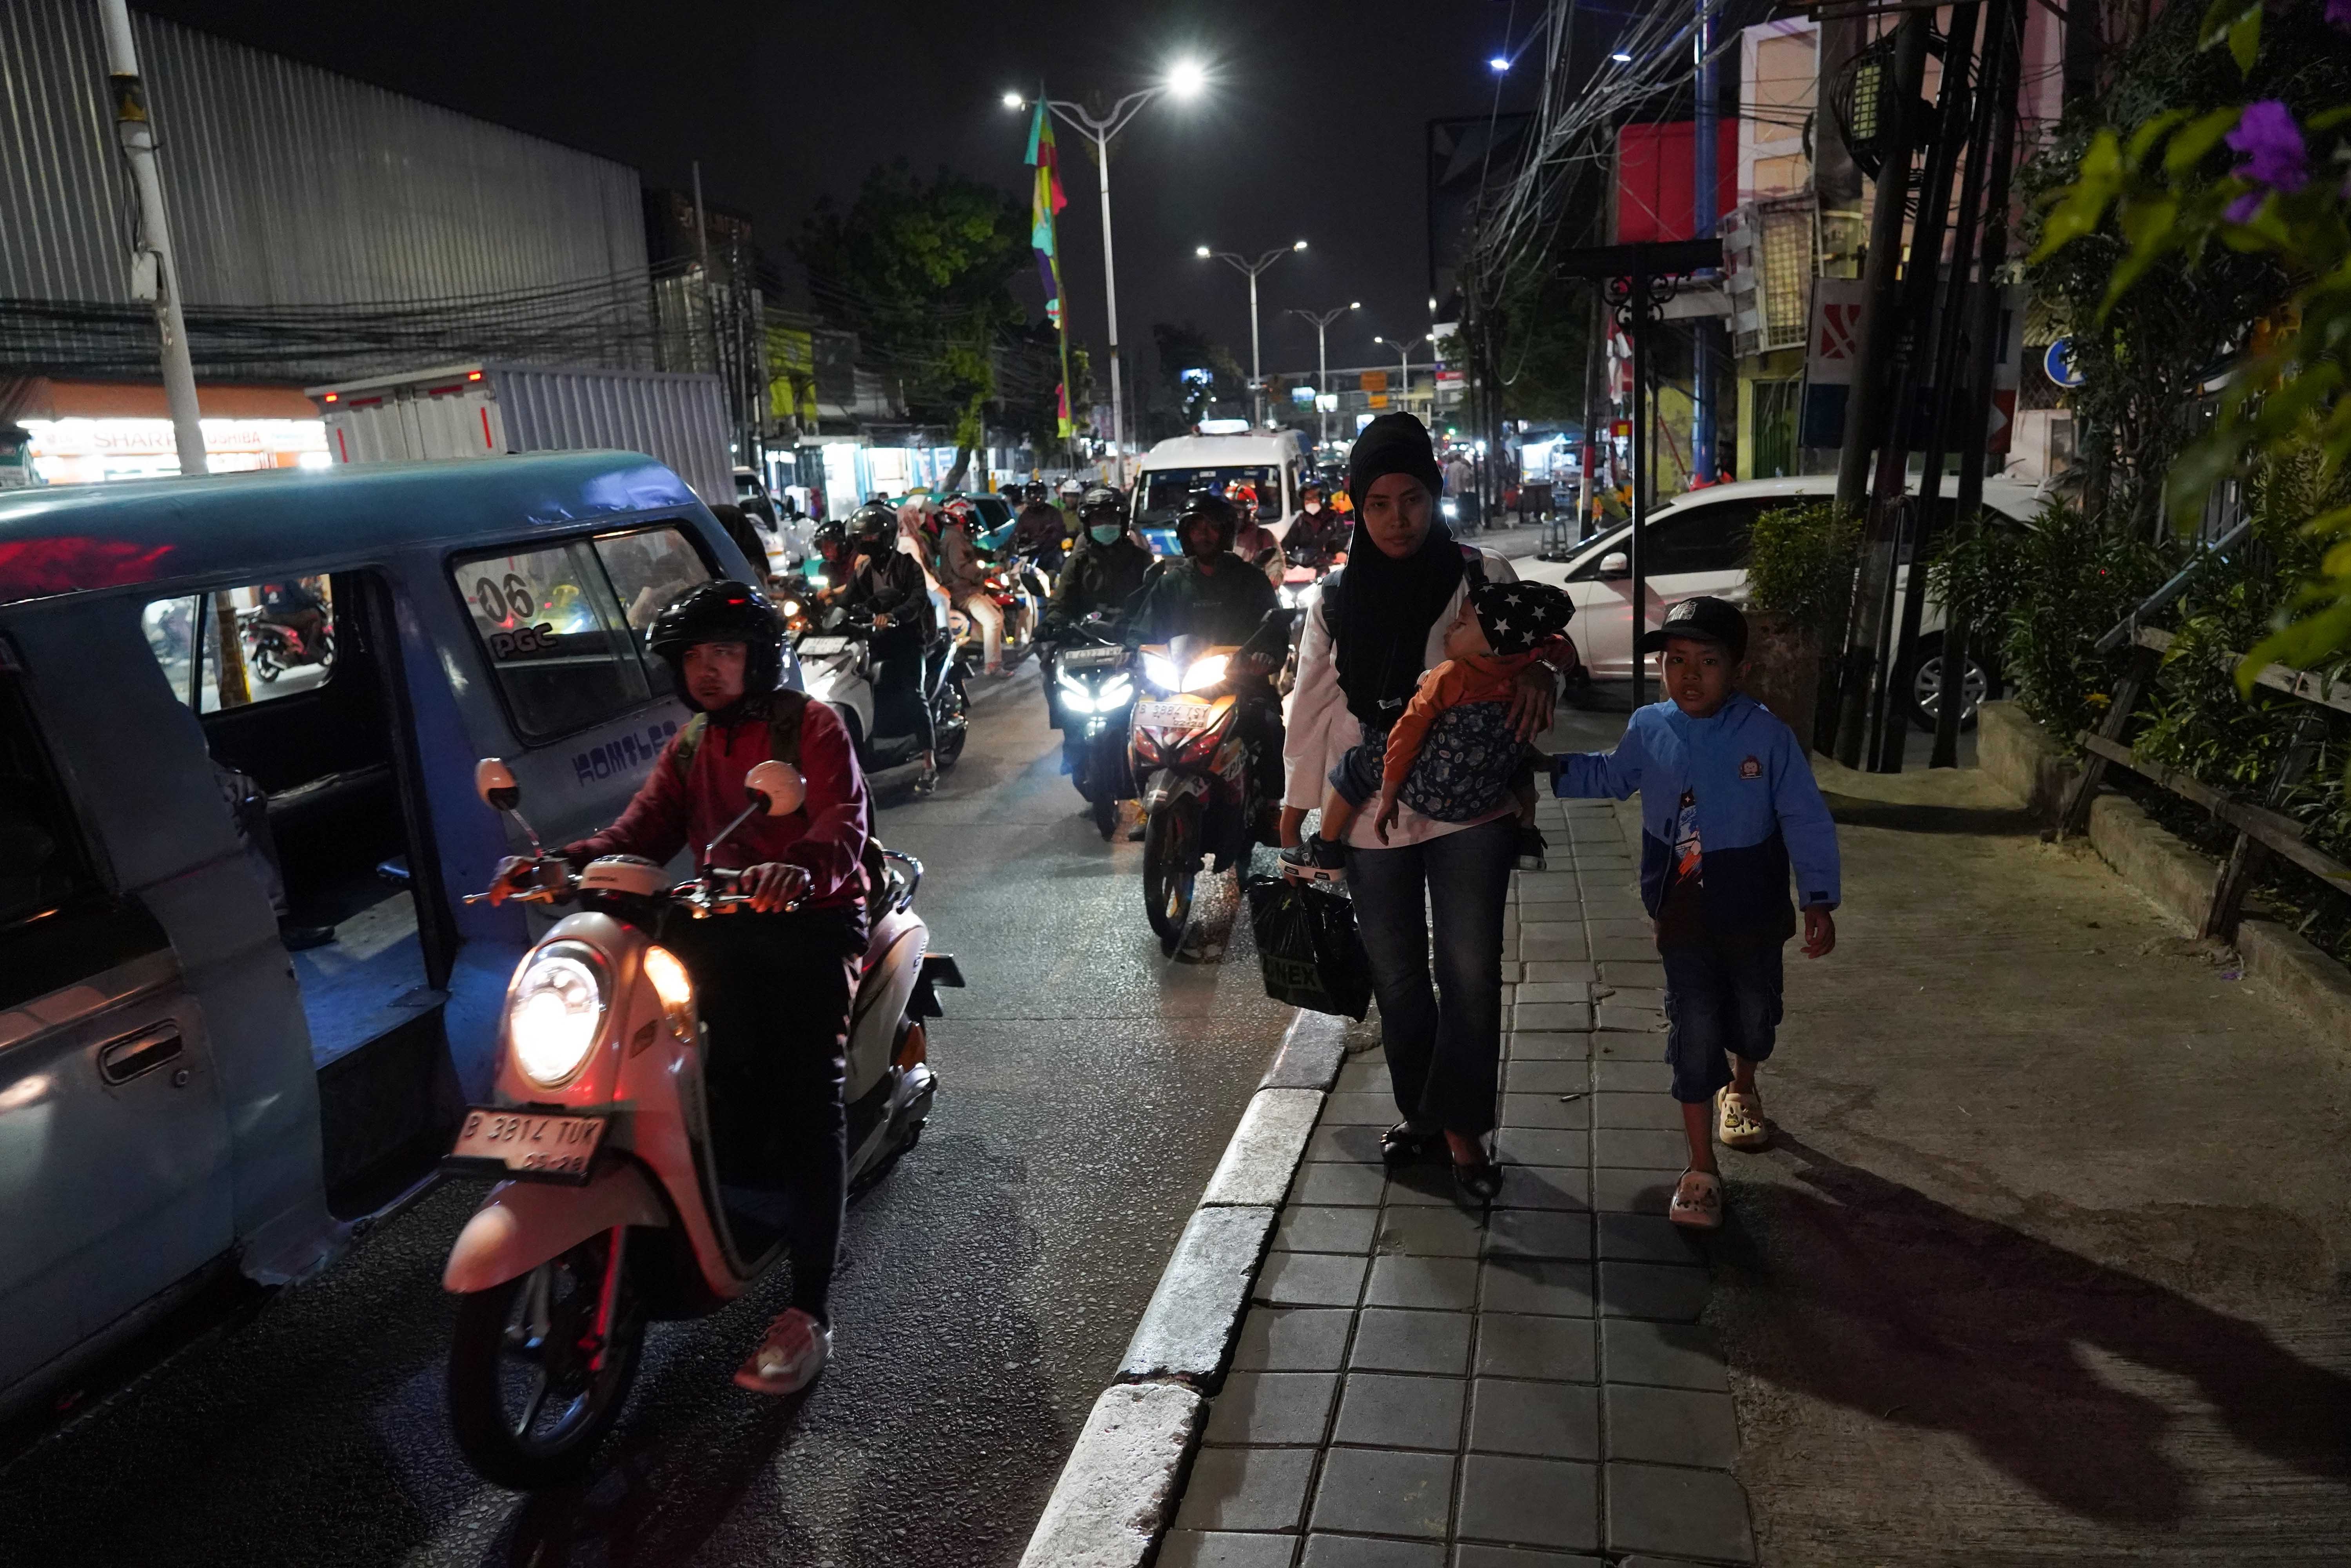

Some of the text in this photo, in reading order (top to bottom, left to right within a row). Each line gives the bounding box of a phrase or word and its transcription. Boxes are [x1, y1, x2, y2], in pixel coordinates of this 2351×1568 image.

[476, 573, 534, 622] 06
[490, 622, 559, 659] PGC
[1140, 704, 1147, 714] B
[1187, 707, 1209, 718] TSY
[464, 1112, 484, 1138] B
[487, 1115, 549, 1142] 3814
